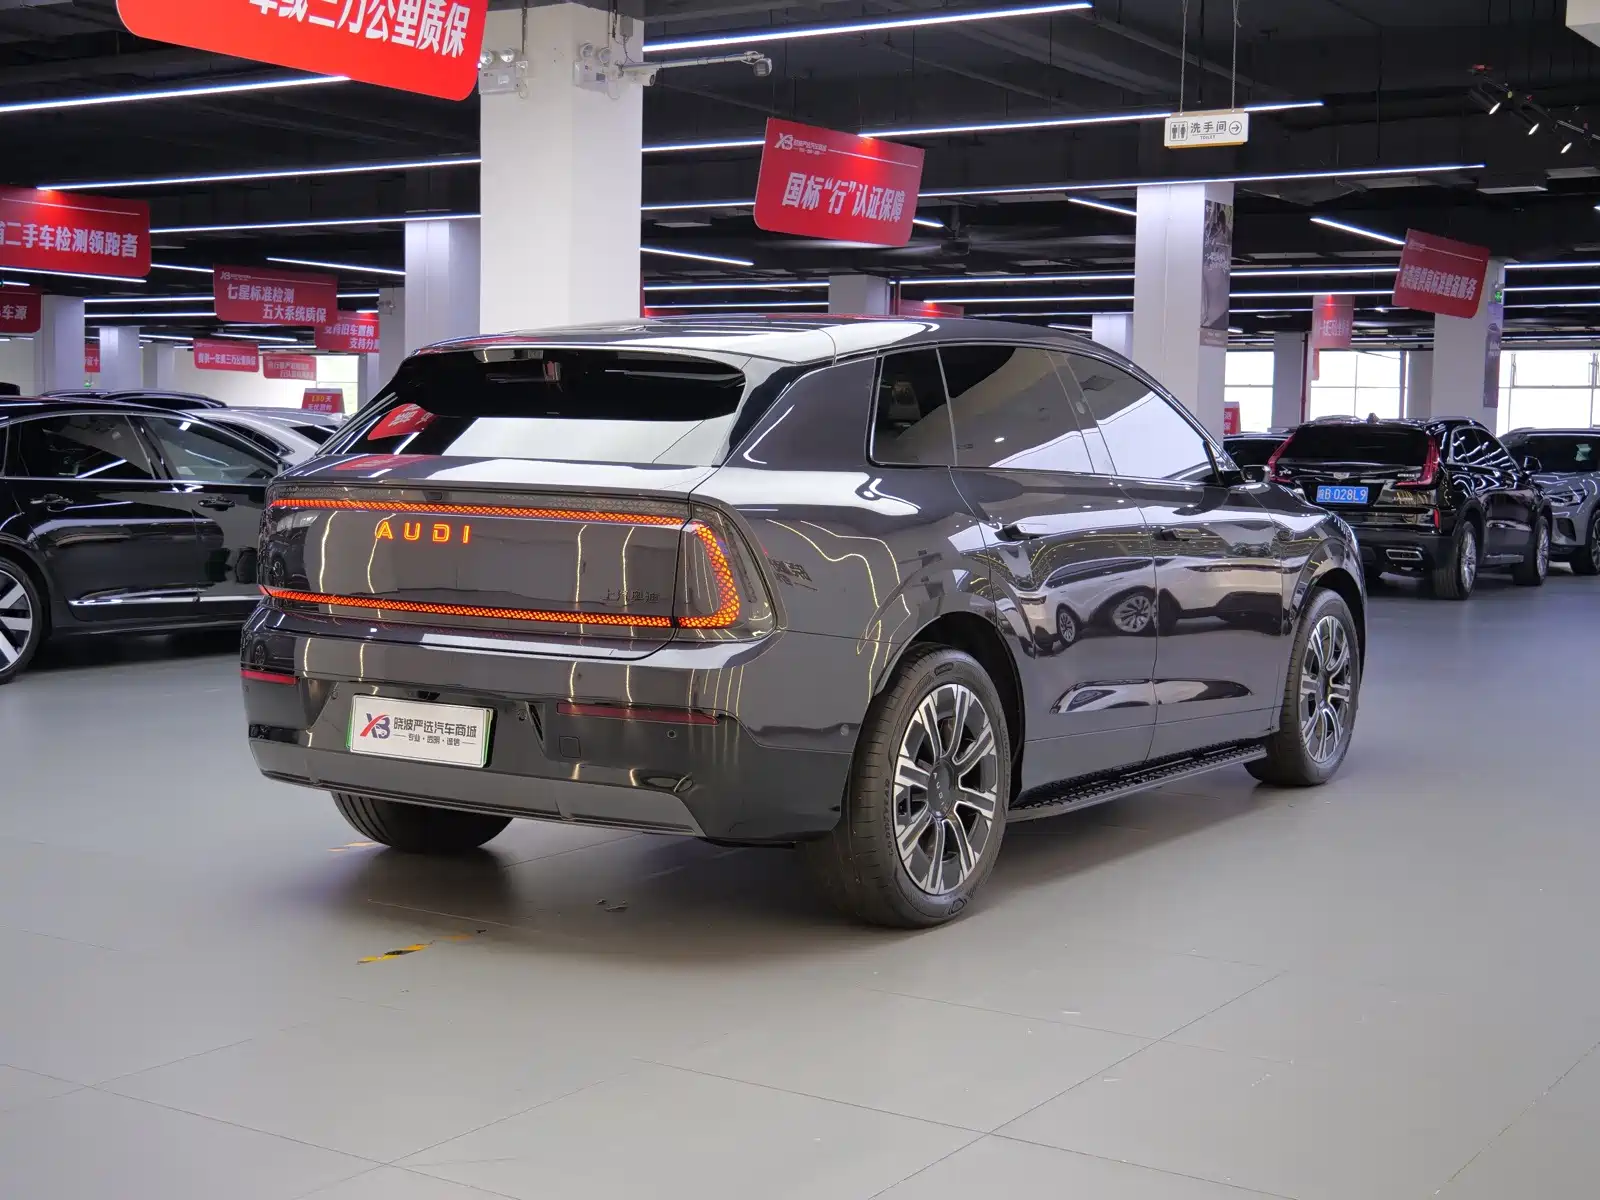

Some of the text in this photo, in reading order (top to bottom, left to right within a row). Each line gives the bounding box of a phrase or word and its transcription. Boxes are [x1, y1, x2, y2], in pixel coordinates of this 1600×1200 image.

[249, 0, 470, 58] 三万公里质保
[1190, 120, 1227, 134] 洗手间
[227, 283, 295, 303] 七星标准检测
[0, 305, 28, 320] 车源
[262, 303, 327, 323] 五大系统质保
[376, 520, 470, 544] AUDI
[393, 716, 477, 738] 晓波严选汽车商城
